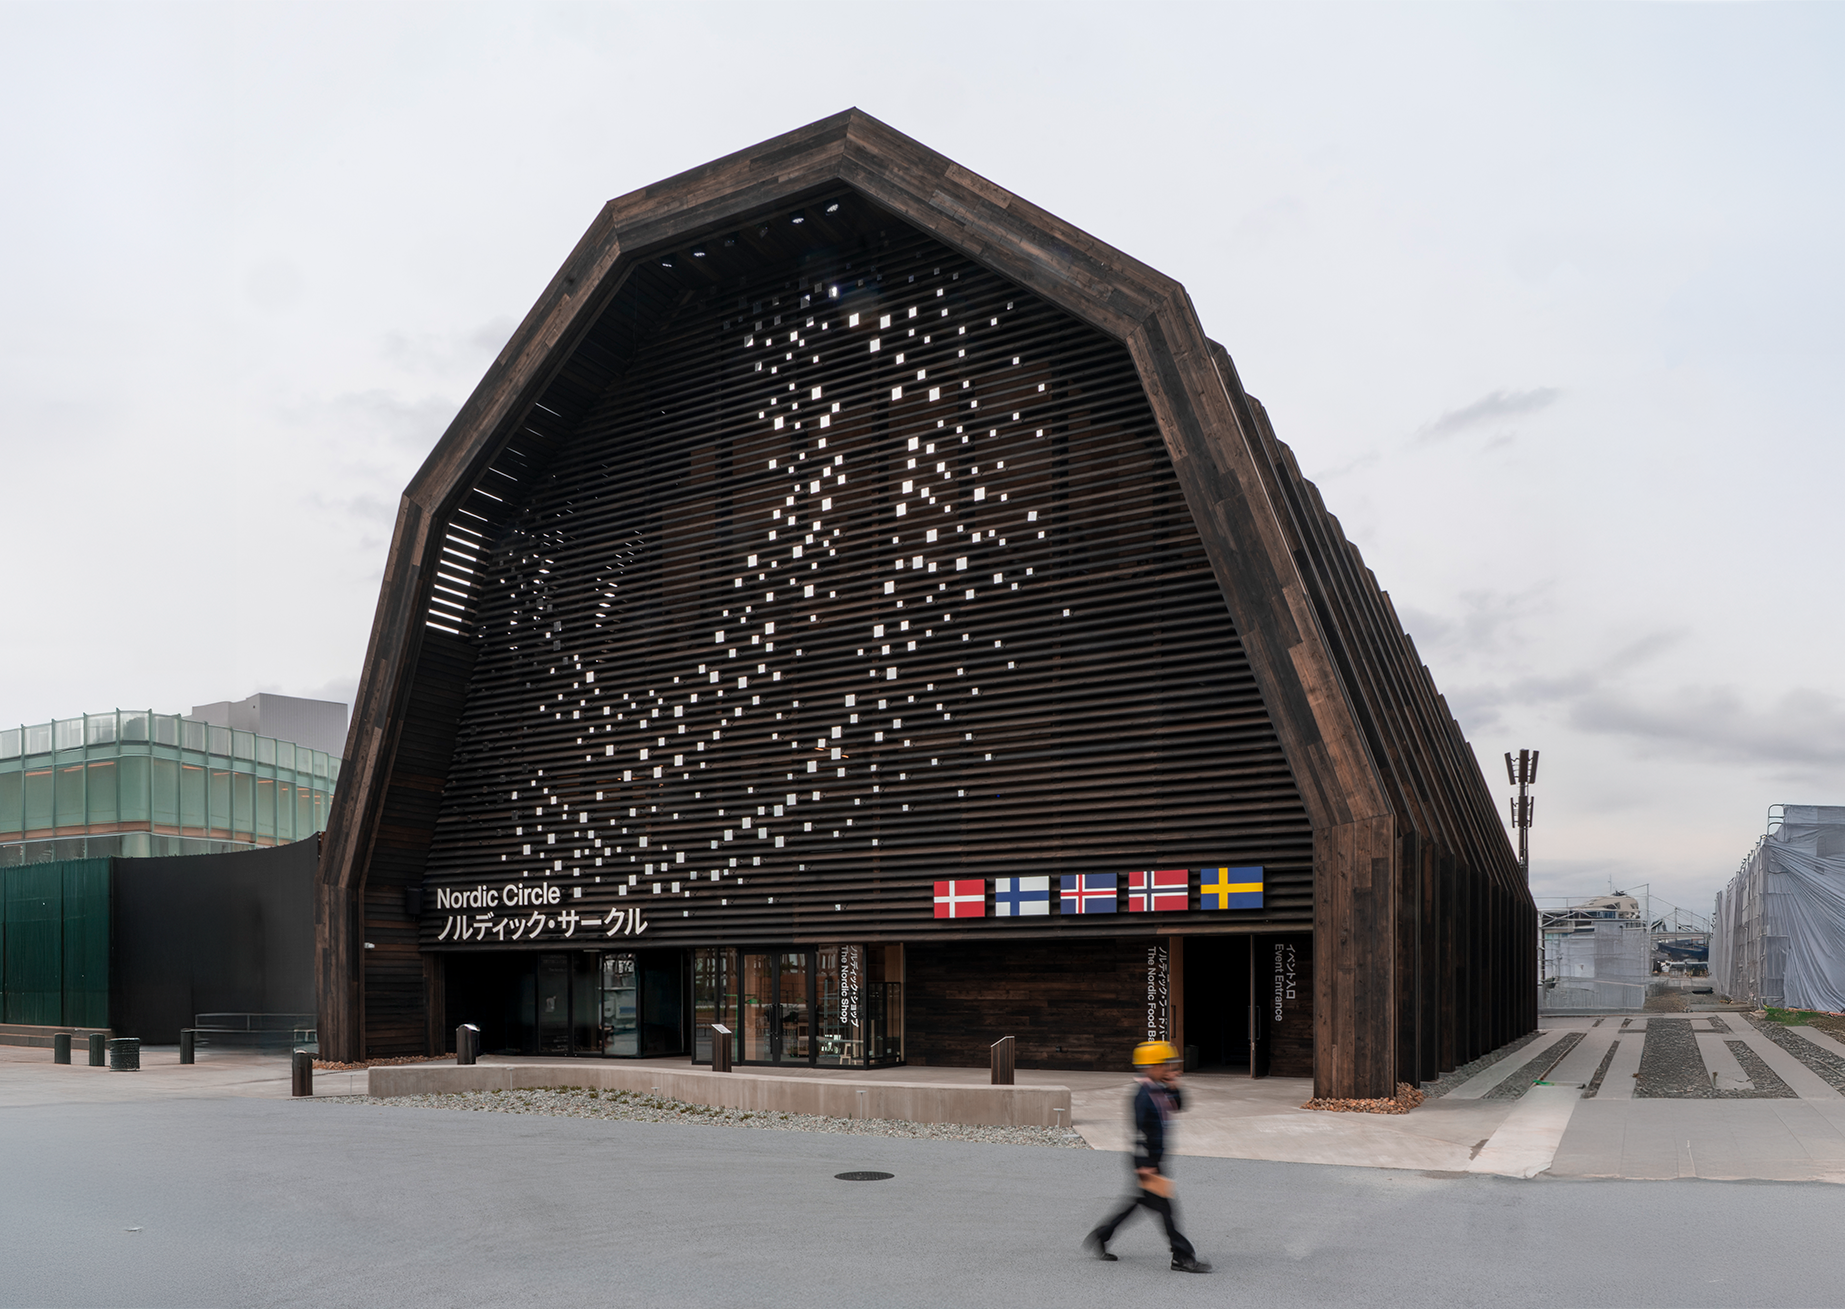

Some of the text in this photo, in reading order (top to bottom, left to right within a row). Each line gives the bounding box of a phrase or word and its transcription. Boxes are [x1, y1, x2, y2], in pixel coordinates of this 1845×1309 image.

[437, 882, 561, 909] Nordic Circle
[437, 907, 649, 941] ノルディック・サークル
[1148, 947, 1156, 966] The
[1286, 944, 1296, 999] イベント入口
[840, 946, 849, 1023] The Nordic Shop
[1148, 968, 1156, 1001] Nordic
[1275, 944, 1284, 1022] Event Entrance
[1148, 1003, 1156, 1028] Food
